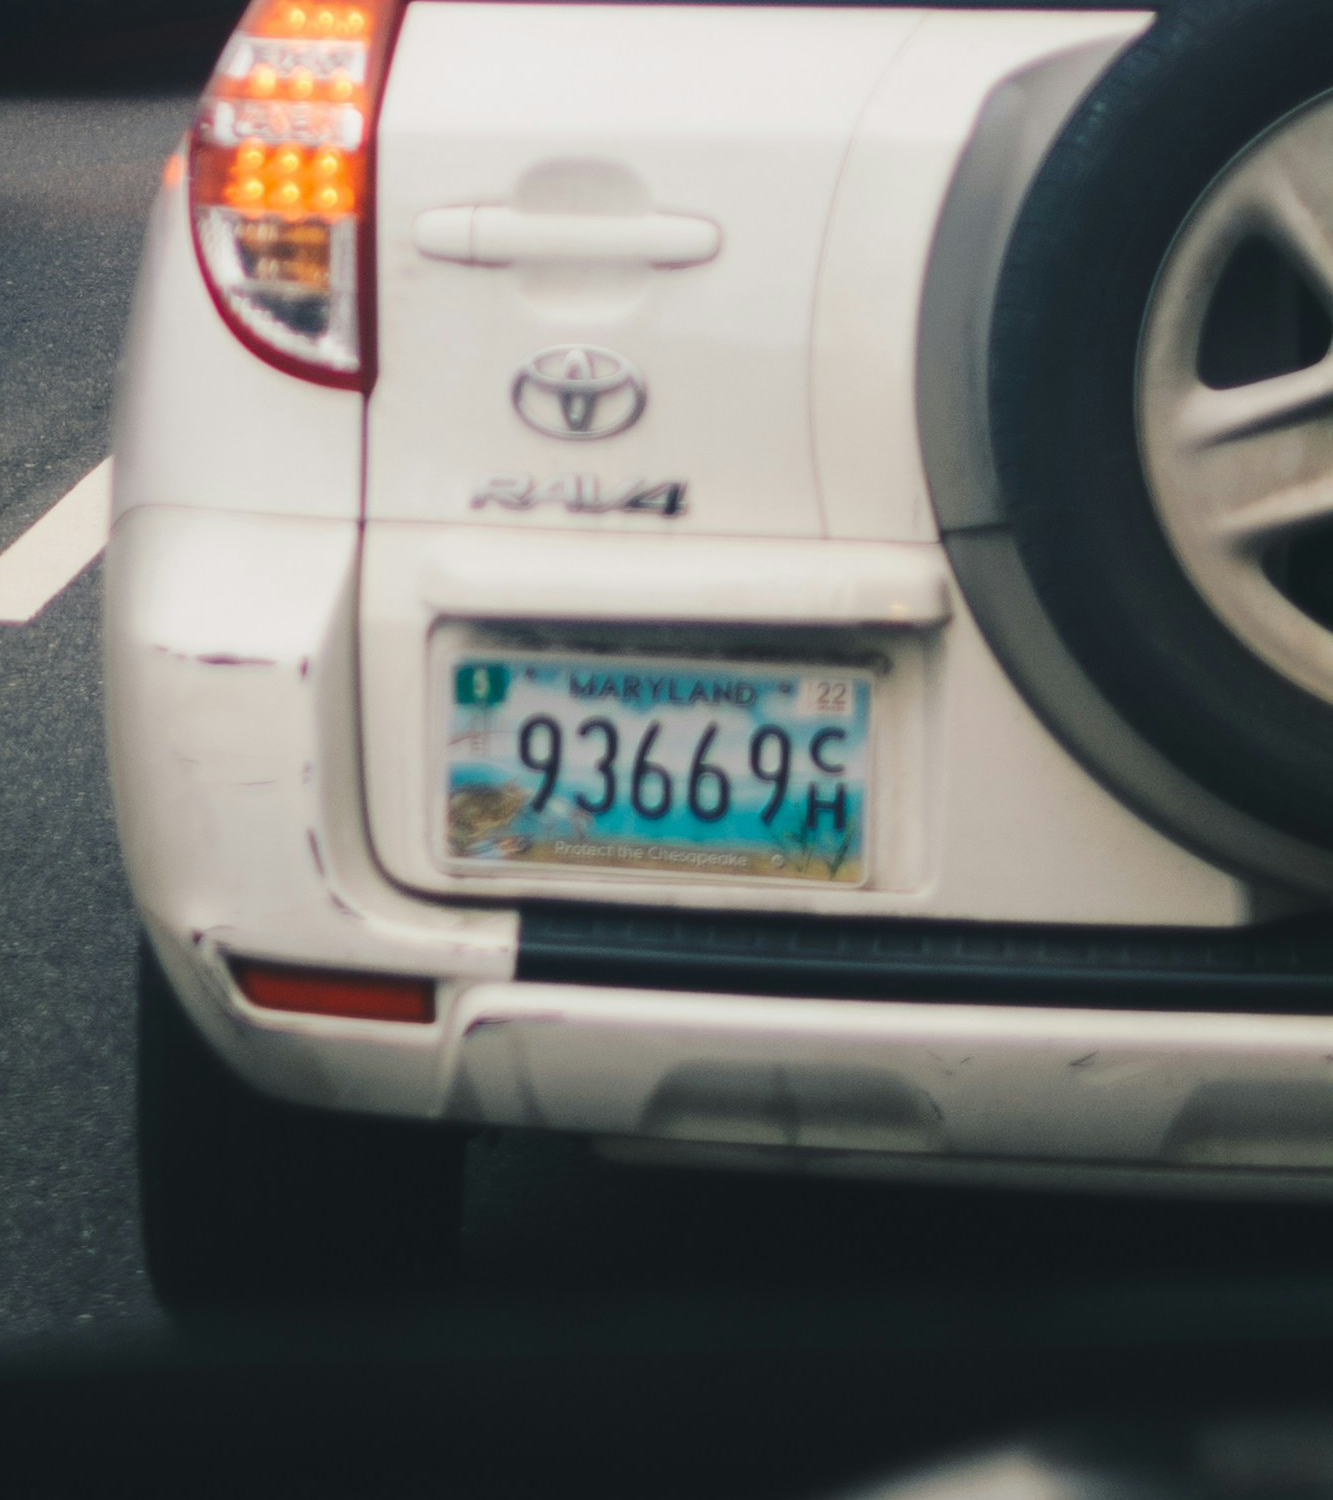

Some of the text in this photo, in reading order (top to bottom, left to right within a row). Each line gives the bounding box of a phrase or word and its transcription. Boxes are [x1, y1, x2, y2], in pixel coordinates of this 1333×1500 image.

[568, 672, 757, 706] MARYLAND
[817, 681, 847, 705] 22
[517, 713, 792, 825] 93669
[554, 839, 749, 868] Protect the Chesapeake
